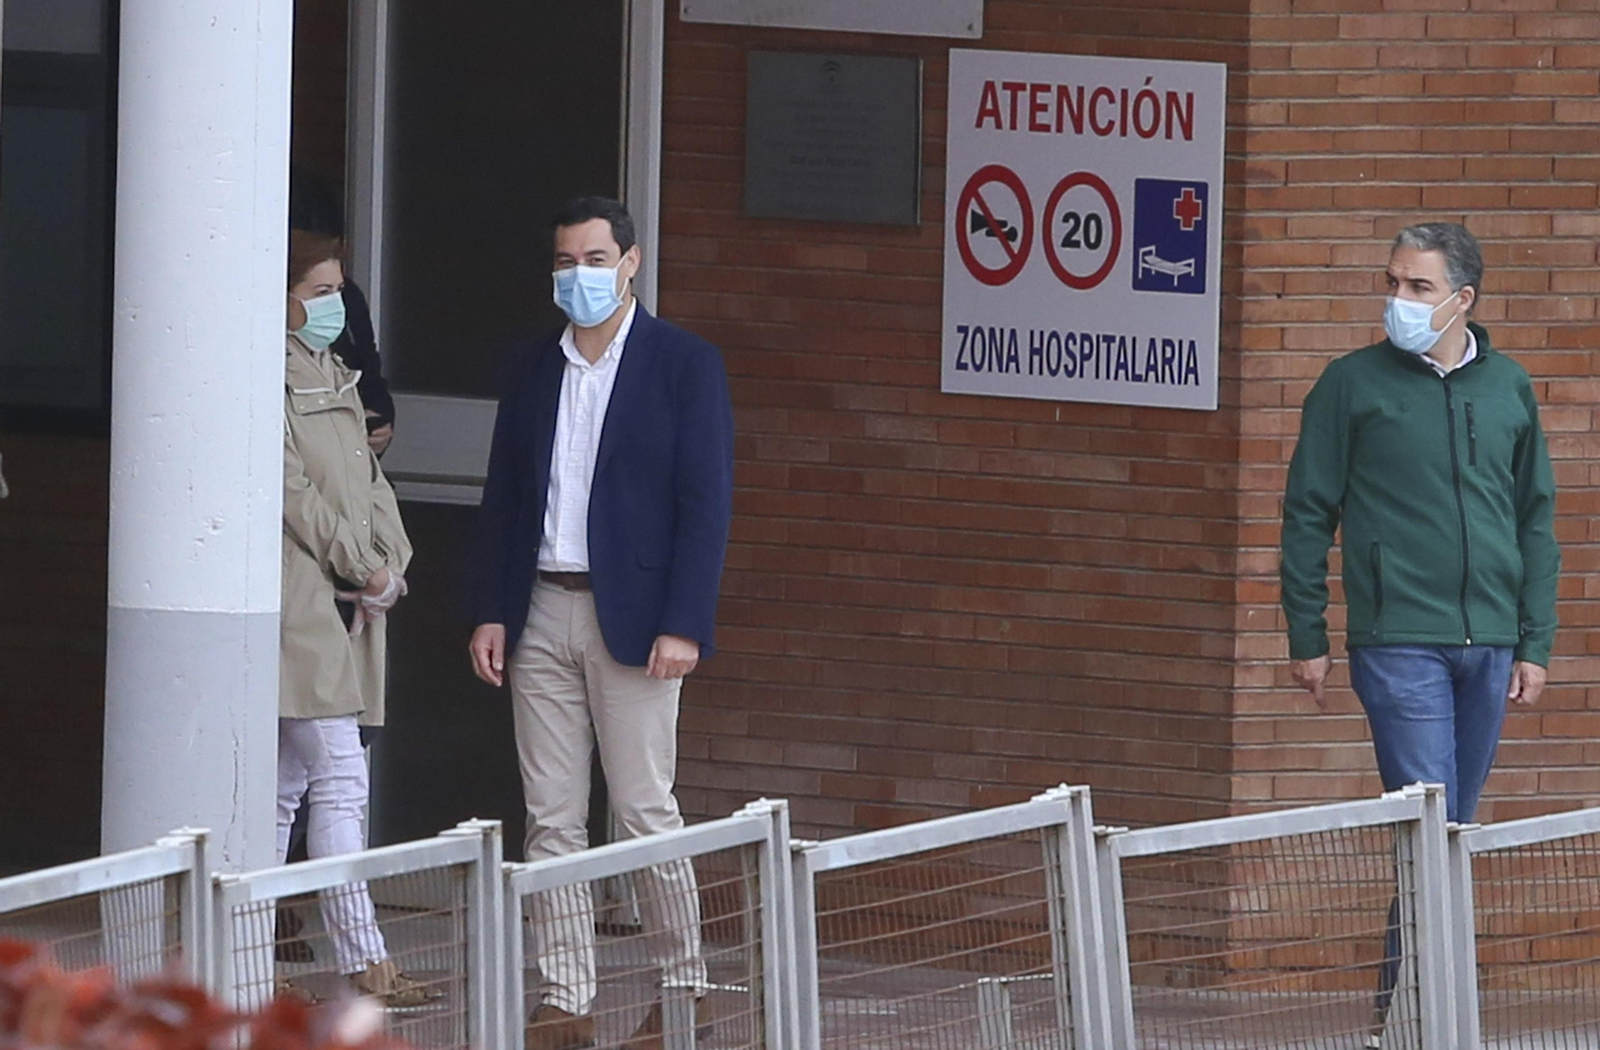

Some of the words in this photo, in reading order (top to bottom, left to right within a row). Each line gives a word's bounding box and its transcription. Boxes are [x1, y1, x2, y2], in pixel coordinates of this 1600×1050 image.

[975, 76, 1194, 141] ATENCIÓN
[1060, 211, 1103, 250] 20
[955, 325, 1020, 374] ZONA
[1029, 329, 1200, 386] HOSPITALARIA
